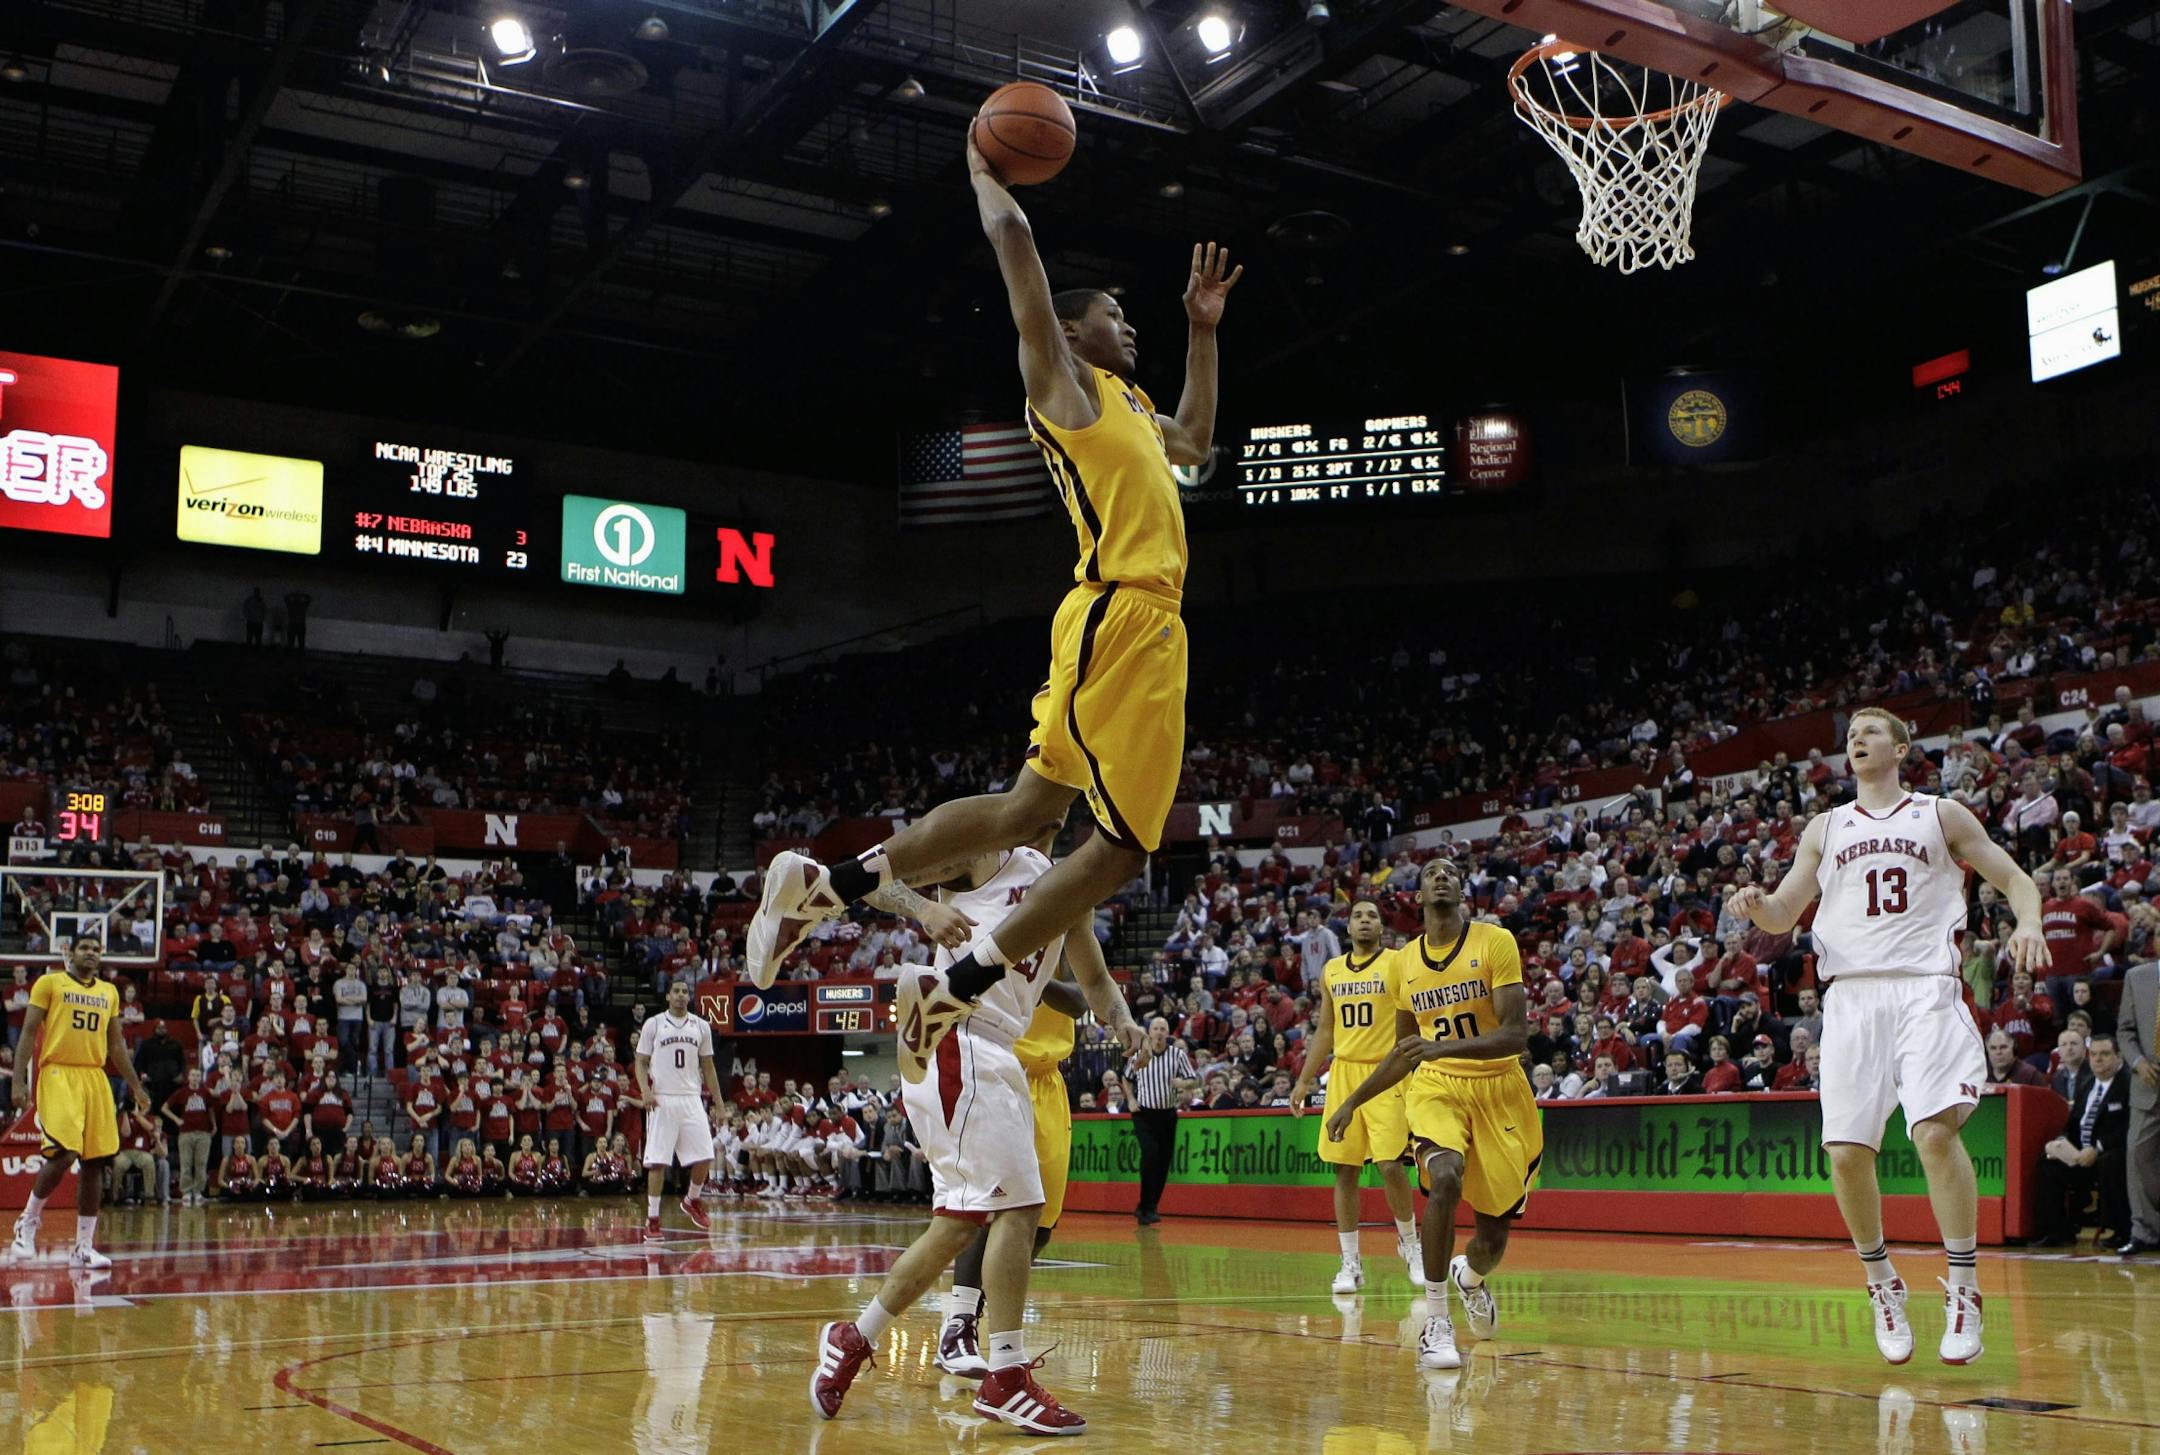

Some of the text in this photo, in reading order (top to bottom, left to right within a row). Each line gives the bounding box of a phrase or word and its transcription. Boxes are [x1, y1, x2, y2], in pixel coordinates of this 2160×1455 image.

[1250, 424, 1312, 441] HUSKERS
[1365, 416, 1428, 432] GOPHERS
[1328, 438, 1349, 451] FG
[1469, 440, 1517, 455] Regional
[375, 442, 513, 475] NCAA WRESTLING
[1469, 453, 1513, 466] Medical
[417, 462, 474, 484] TOP 25
[1326, 461, 1353, 476] 3PT
[1469, 468, 1507, 480] Center
[409, 474, 478, 499] 149 LBS
[1330, 485, 1350, 499] FT
[355, 512, 528, 546] #7 NEBRASKA 3
[355, 535, 528, 569] #4 MINNESOTA 23
[716, 527, 775, 588] N
[567, 562, 679, 591] First National
[2060, 688, 2088, 706] C24
[68, 793, 105, 812] 3:08
[58, 811, 100, 841] 34
[199, 822, 223, 836] C18
[1198, 804, 1233, 836] N
[314, 829, 338, 842] C19
[484, 814, 518, 846] N
[1278, 825, 1300, 838] C21
[1835, 838, 1930, 871] NEBRASKA
[1865, 867, 1908, 916] 13
[825, 988, 863, 1000] HUSKERS
[1330, 980, 1386, 998] MINNESOTA
[1410, 979, 1488, 1013] MINNESOTA
[63, 991, 109, 1009] MINNESOTA
[766, 1000, 807, 1019] pepsi
[701, 995, 730, 1025] N
[1340, 1002, 1374, 1029] 00
[72, 1010, 99, 1032] 50
[835, 1011, 859, 1031] 48
[1433, 1012, 1480, 1042] 20
[660, 1036, 698, 1048] NEBRASKA
[674, 1049, 685, 1069] 0
[731, 1057, 757, 1076] A4
[1959, 1083, 1978, 1099] N
